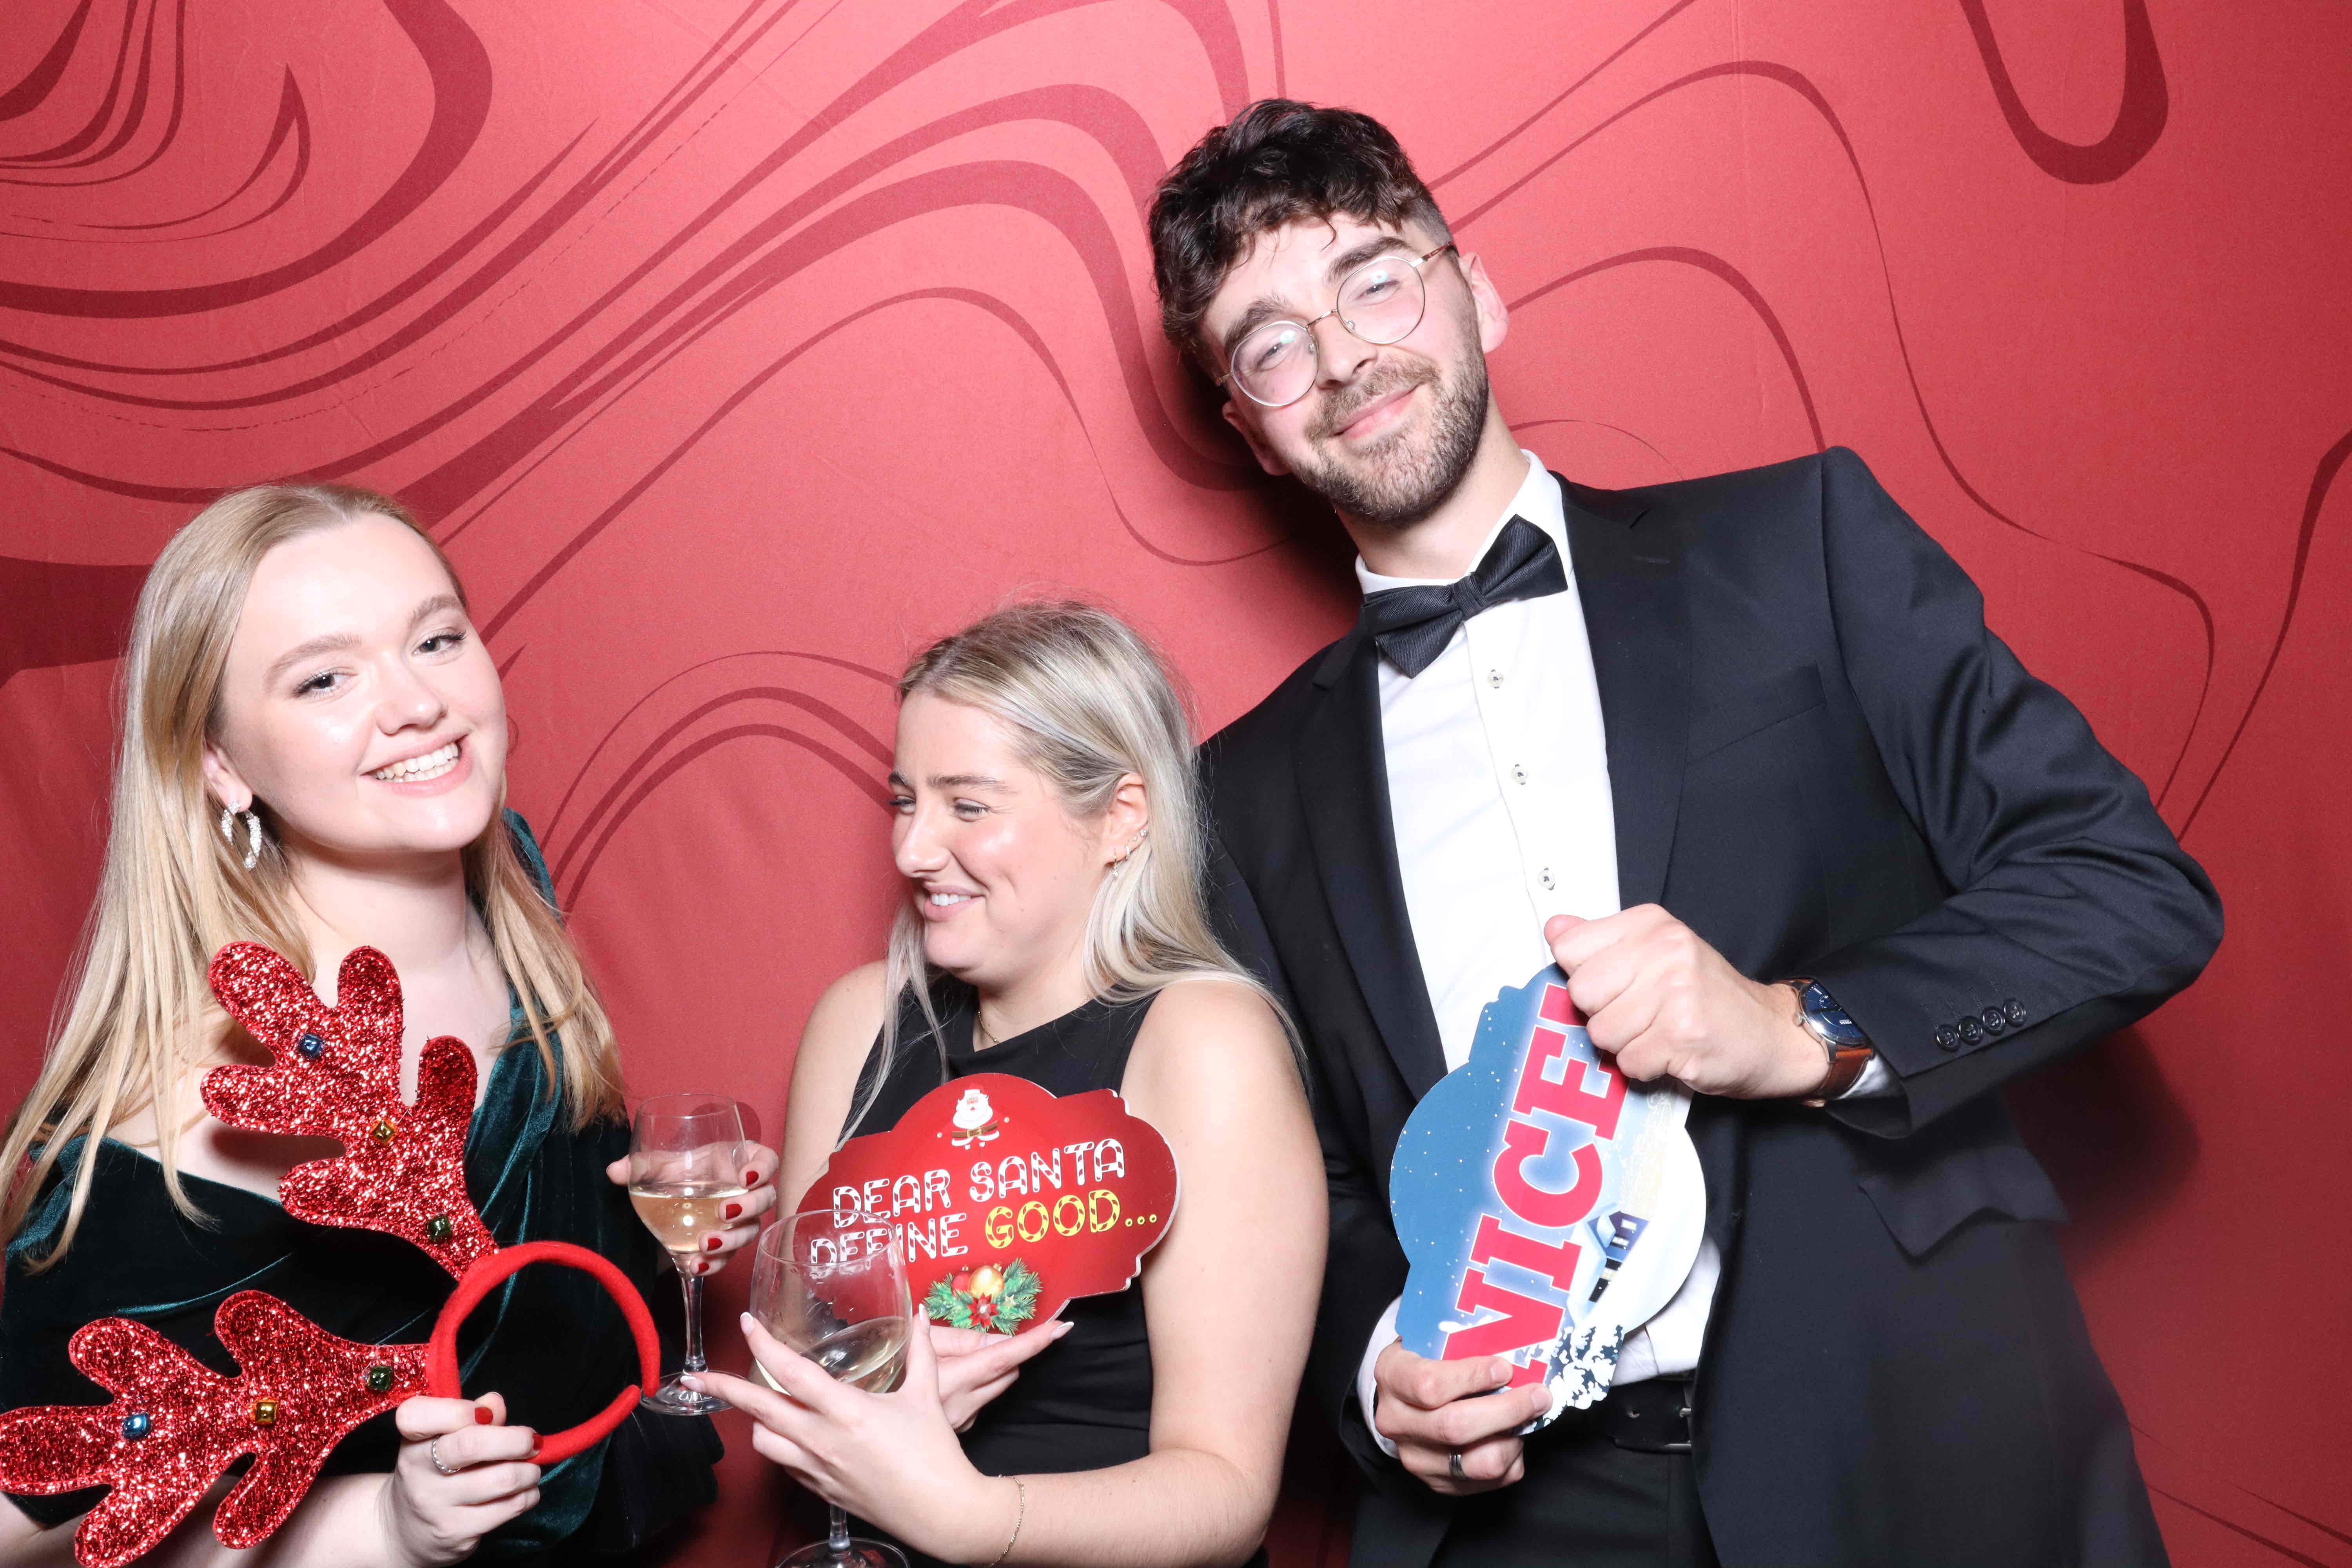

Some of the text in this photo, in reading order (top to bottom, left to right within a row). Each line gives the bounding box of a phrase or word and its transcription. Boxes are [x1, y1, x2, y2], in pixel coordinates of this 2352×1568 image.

[833, 1138, 1125, 1229] DEAR SANTA
[810, 1212, 969, 1274] DEFINE
